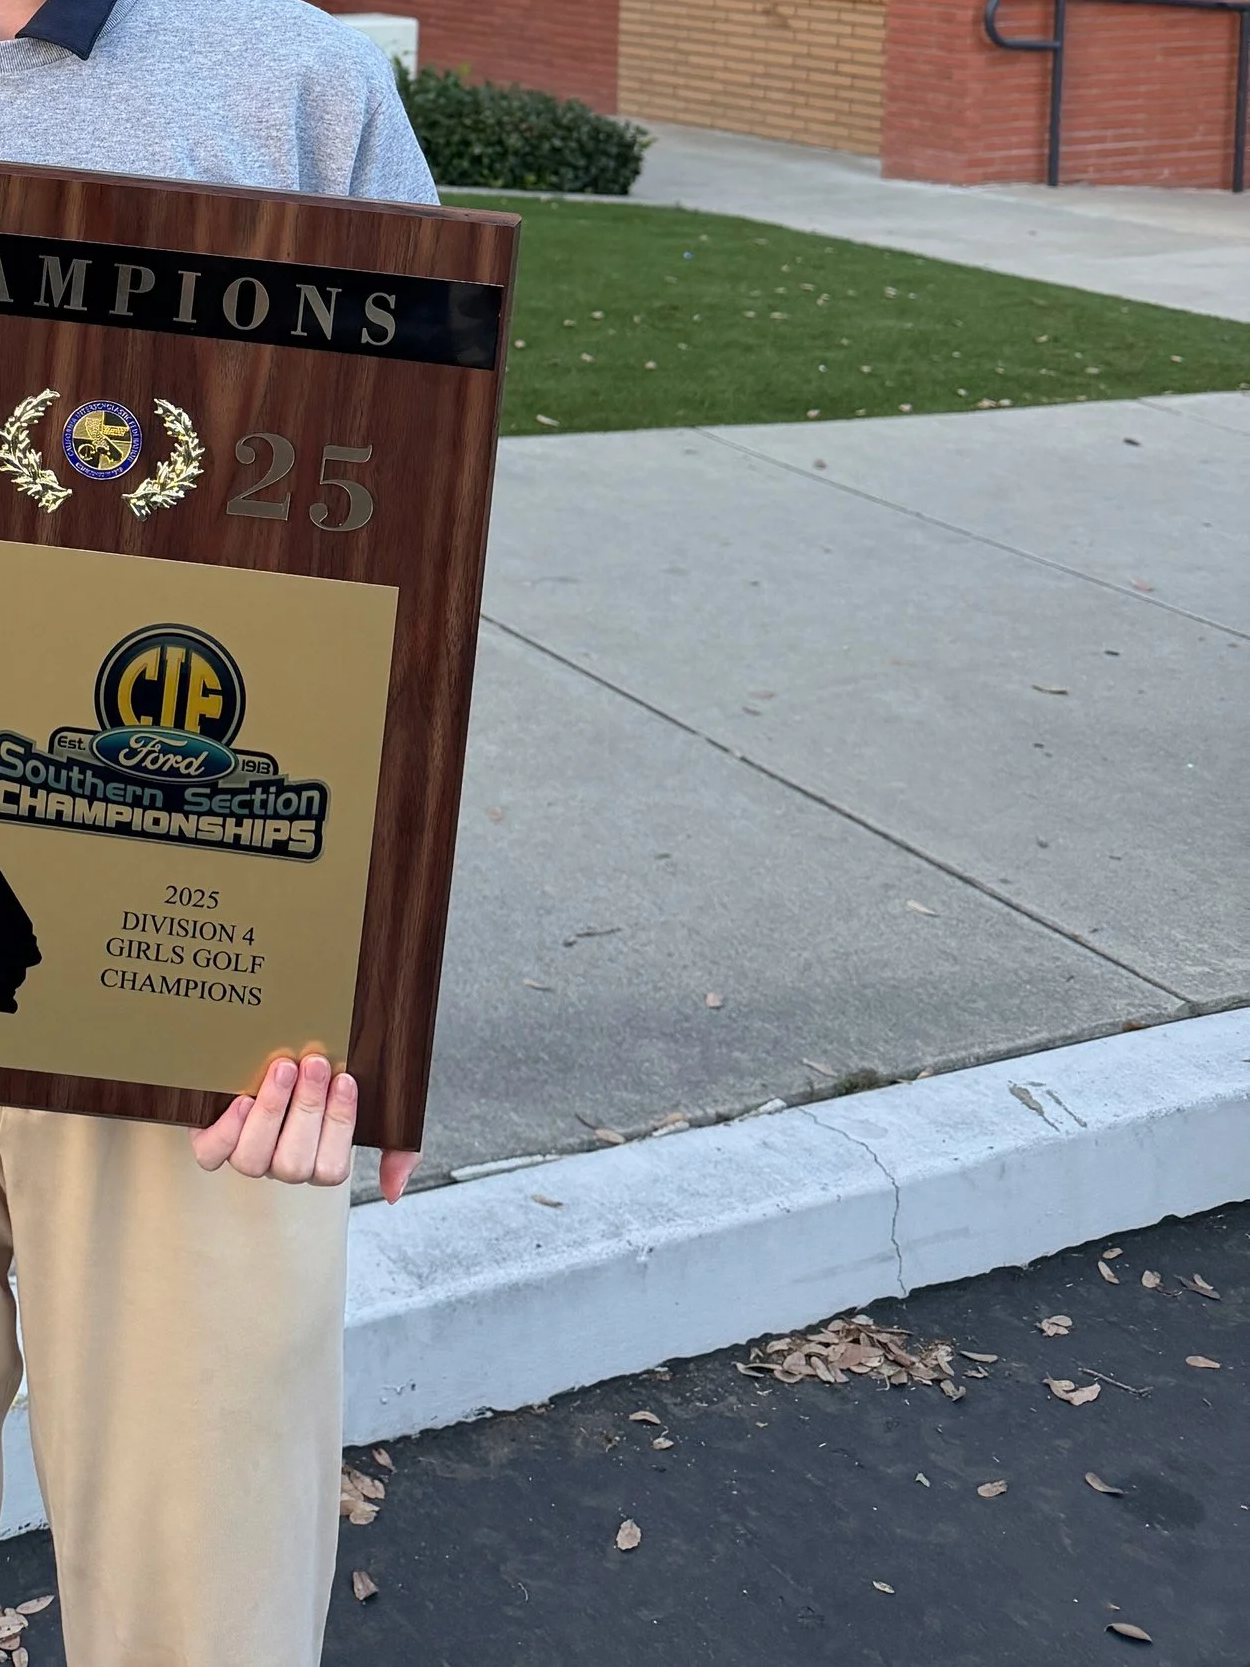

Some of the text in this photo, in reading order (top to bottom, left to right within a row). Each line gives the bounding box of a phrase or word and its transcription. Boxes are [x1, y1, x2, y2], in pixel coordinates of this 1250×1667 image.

[226, 433, 374, 531] 25
[117, 646, 223, 734] CIF
[56, 735, 271, 775] Est. 1913
[118, 733, 209, 776] Ford
[183, 786, 321, 816] Section
[164, 885, 220, 910] 2025
[122, 910, 255, 946] DIVISION 4
[105, 937, 265, 974] GIRLS GOLF
[100, 968, 262, 1006] CHAMPIONS
